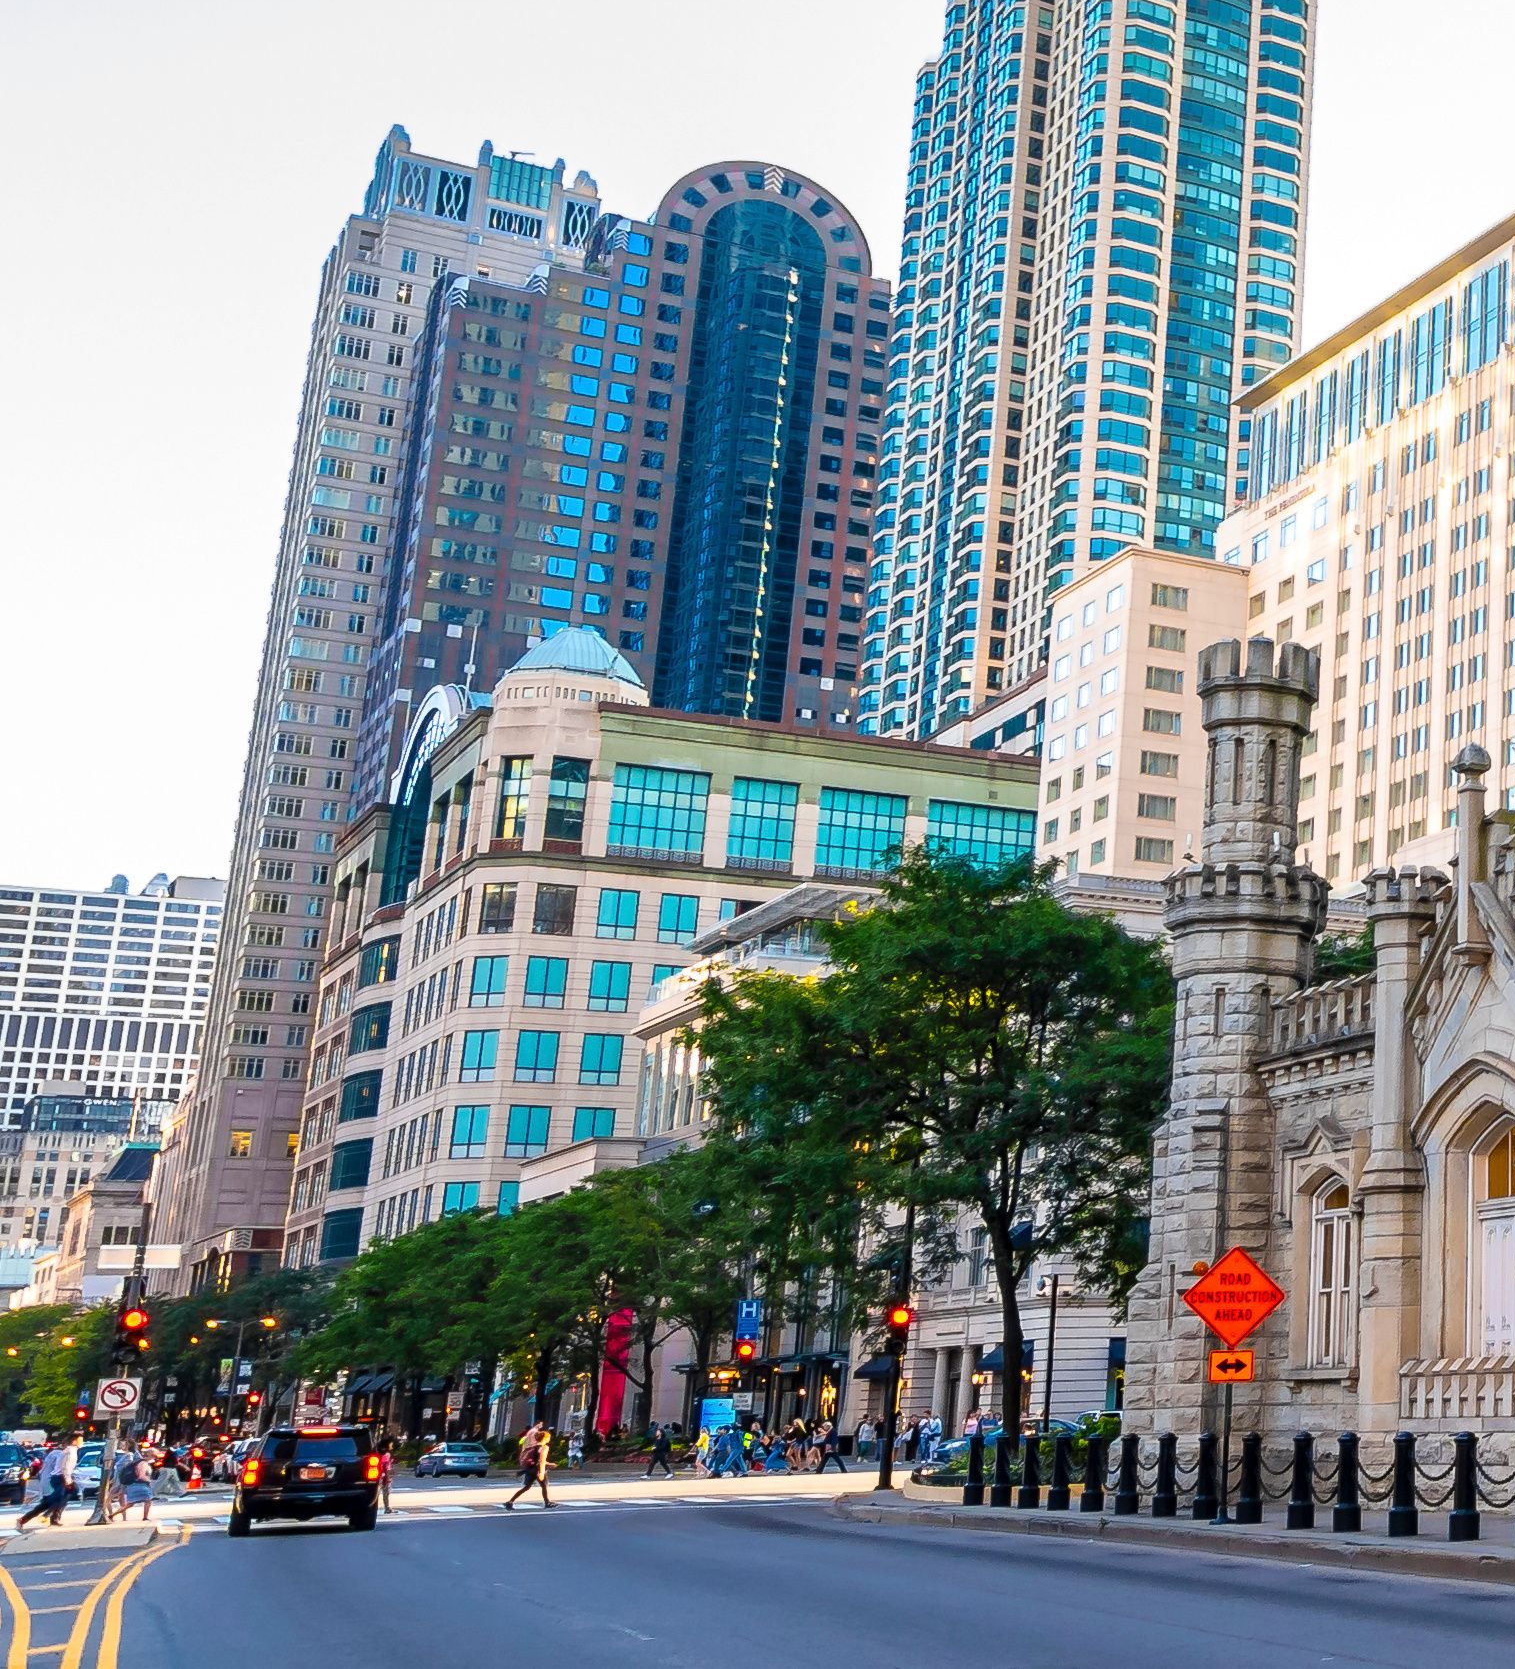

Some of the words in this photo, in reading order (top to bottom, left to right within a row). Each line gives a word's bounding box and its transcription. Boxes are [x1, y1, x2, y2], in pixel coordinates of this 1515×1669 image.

[83, 1098, 118, 1106] GWEN
[1219, 1272, 1252, 1286] ROAD
[1190, 1290, 1278, 1304] CONSTRUCTION
[741, 1302, 758, 1318] H
[1214, 1308, 1253, 1322] AHEAD
